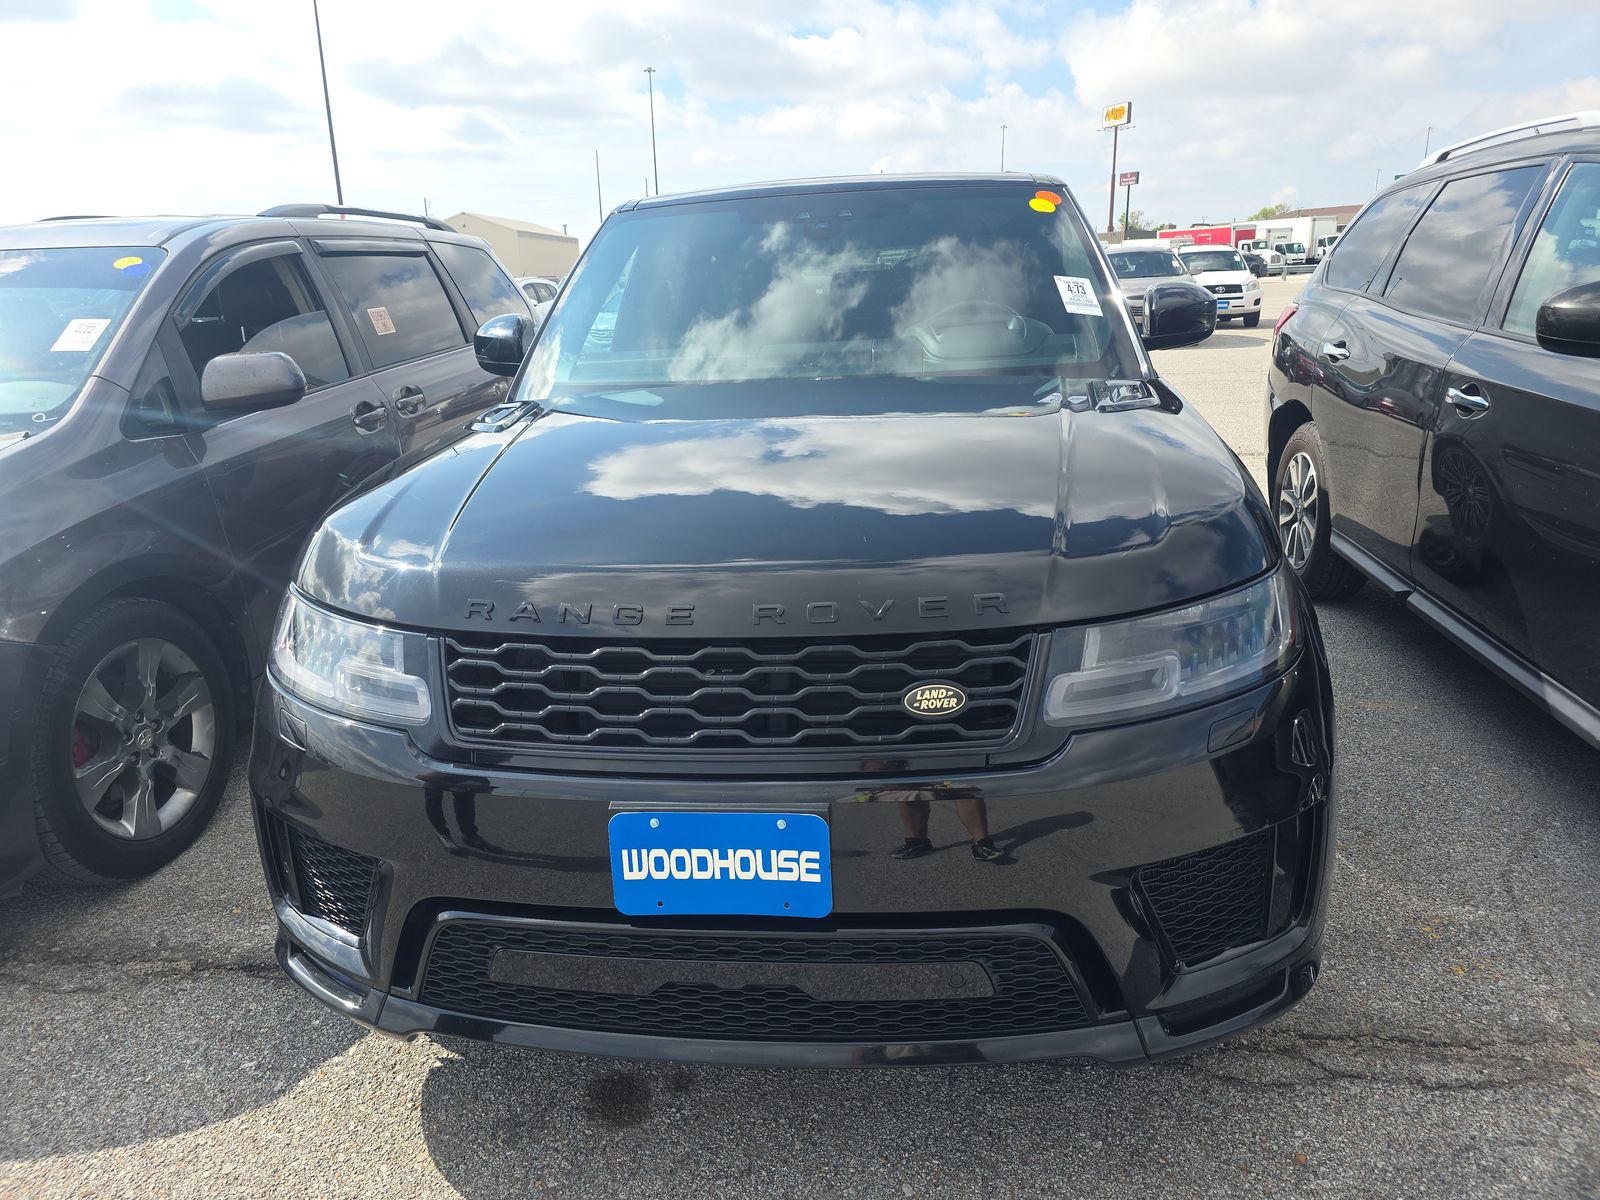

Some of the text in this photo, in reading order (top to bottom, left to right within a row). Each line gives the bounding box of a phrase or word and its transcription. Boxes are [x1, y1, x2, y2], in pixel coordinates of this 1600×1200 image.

[464, 592, 1010, 626] RANGE ROVER
[917, 689, 946, 699] LAND
[920, 698, 957, 709] ROVER
[621, 848, 822, 883] WOODHOUSE
